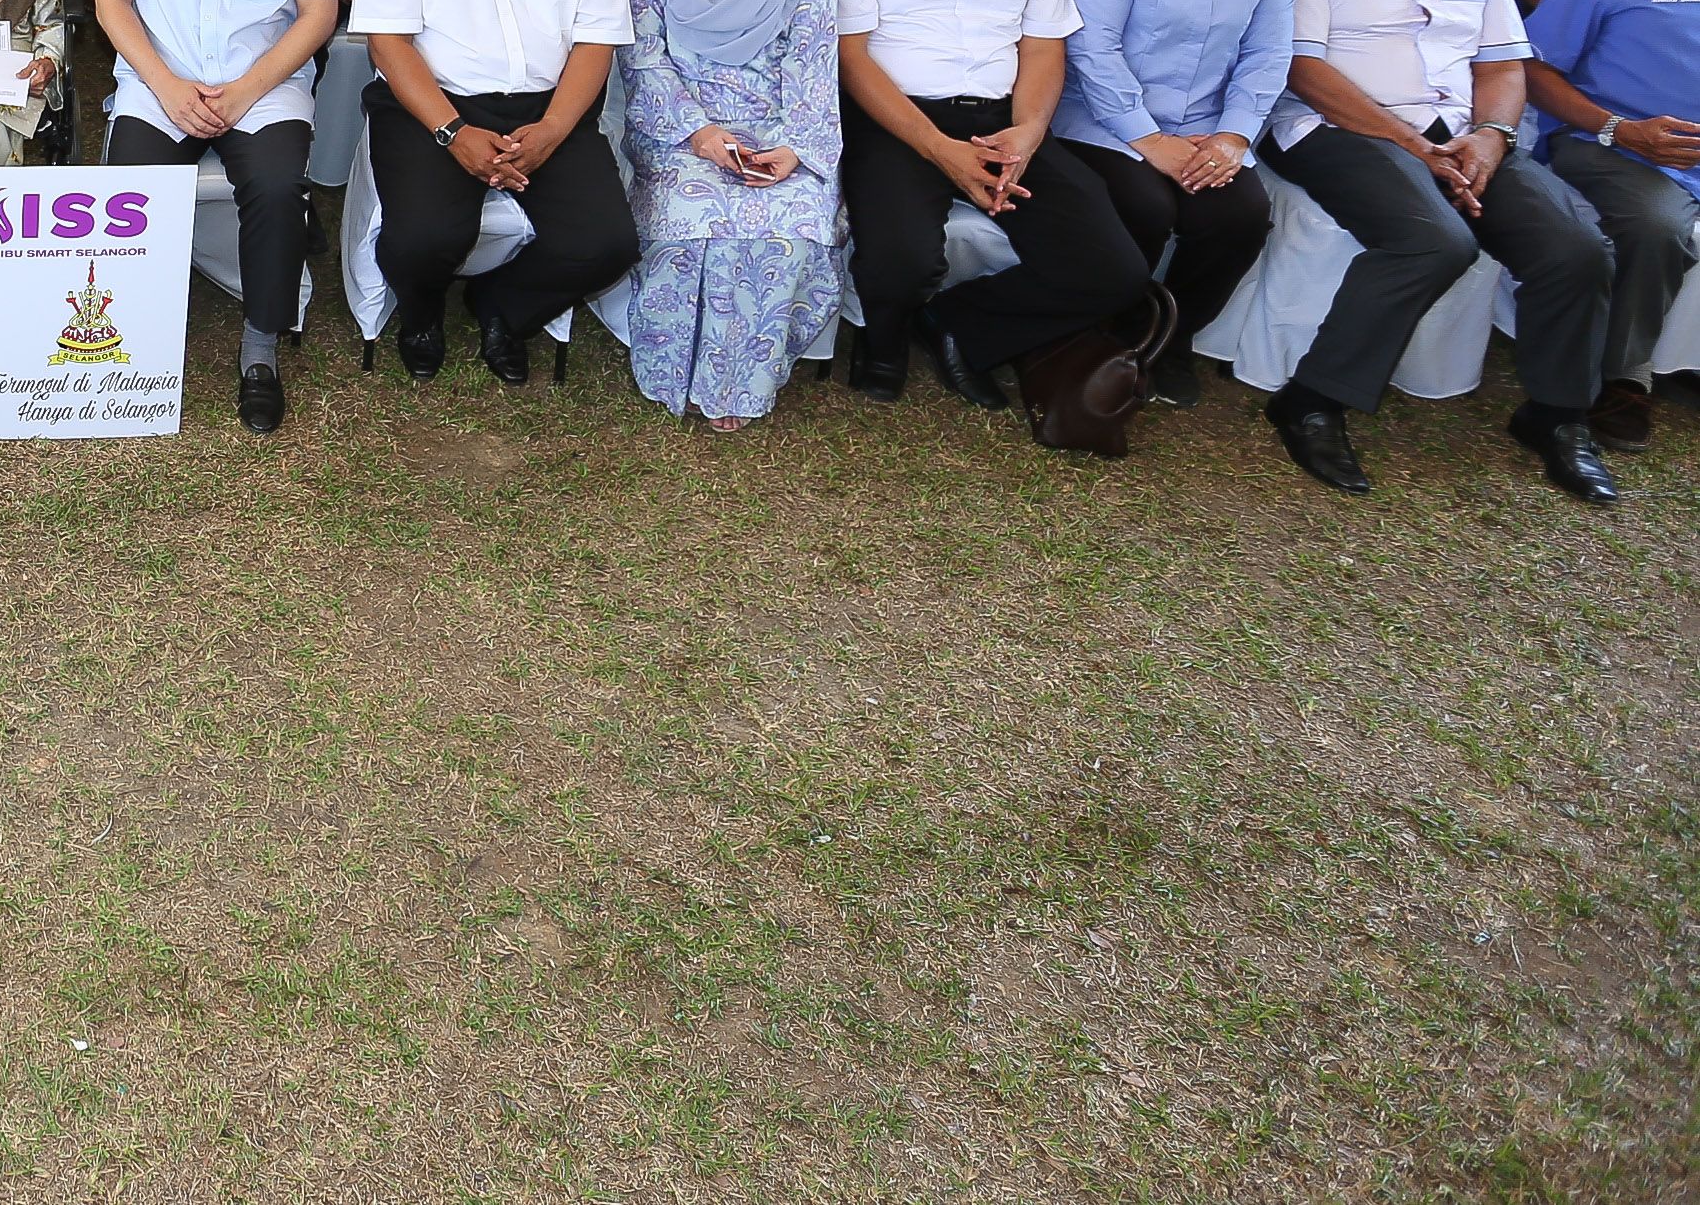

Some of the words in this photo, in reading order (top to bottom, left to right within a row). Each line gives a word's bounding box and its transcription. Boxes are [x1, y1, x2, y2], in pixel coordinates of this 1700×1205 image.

[1, 250, 23, 258] IBU
[27, 249, 72, 258] SMART
[75, 248, 147, 256] SELANGOR
[63, 351, 116, 361] SELANGOR
[74, 374, 91, 393] di
[97, 371, 180, 395] Malaysia
[18, 401, 75, 425] Hanya
[79, 401, 97, 420] di
[102, 398, 177, 423] Selangor
